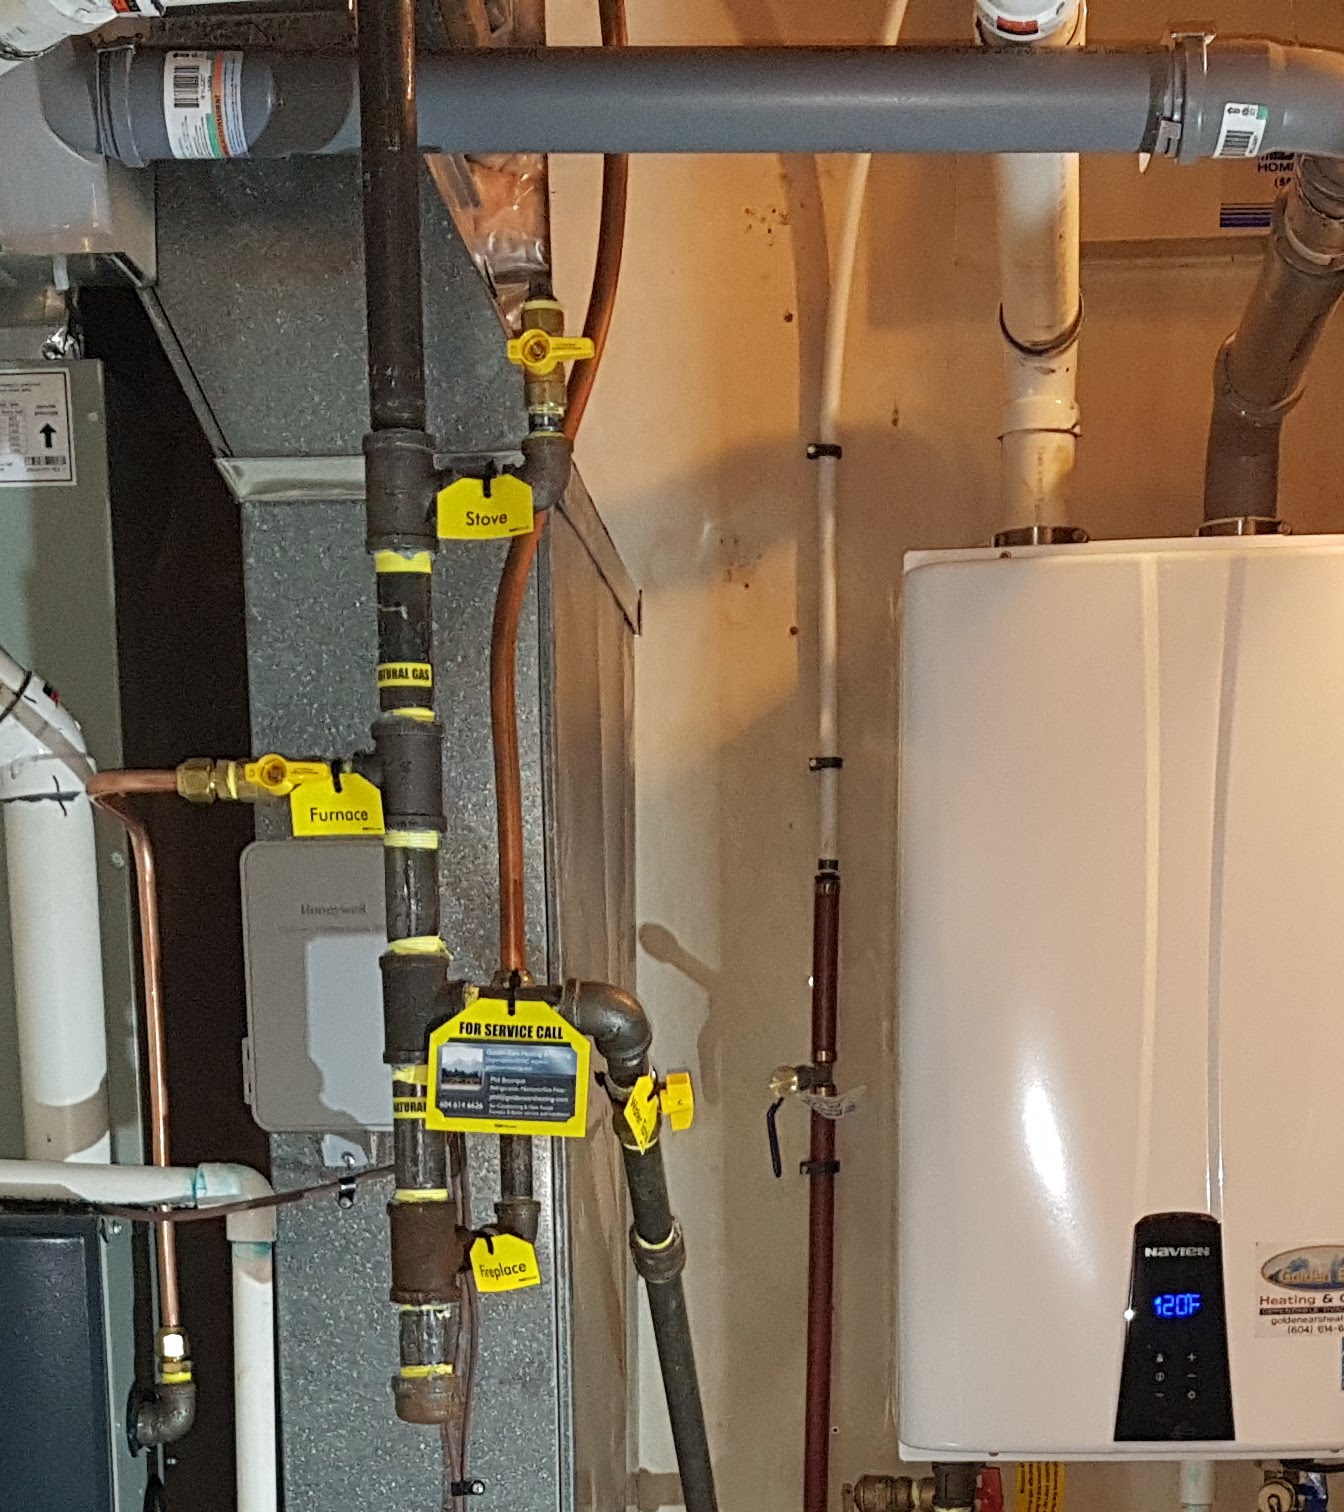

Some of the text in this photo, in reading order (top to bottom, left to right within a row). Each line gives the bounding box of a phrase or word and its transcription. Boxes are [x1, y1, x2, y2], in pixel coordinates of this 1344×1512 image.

[465, 511, 508, 526] Stove
[412, 667, 430, 681] GAS
[309, 807, 369, 822] Furnace
[459, 1021, 564, 1040] FOR SERVICE CALL
[479, 1262, 527, 1280] Fireplace
[1259, 1294, 1316, 1307] Heating
[1322, 1293, 1334, 1304] &
